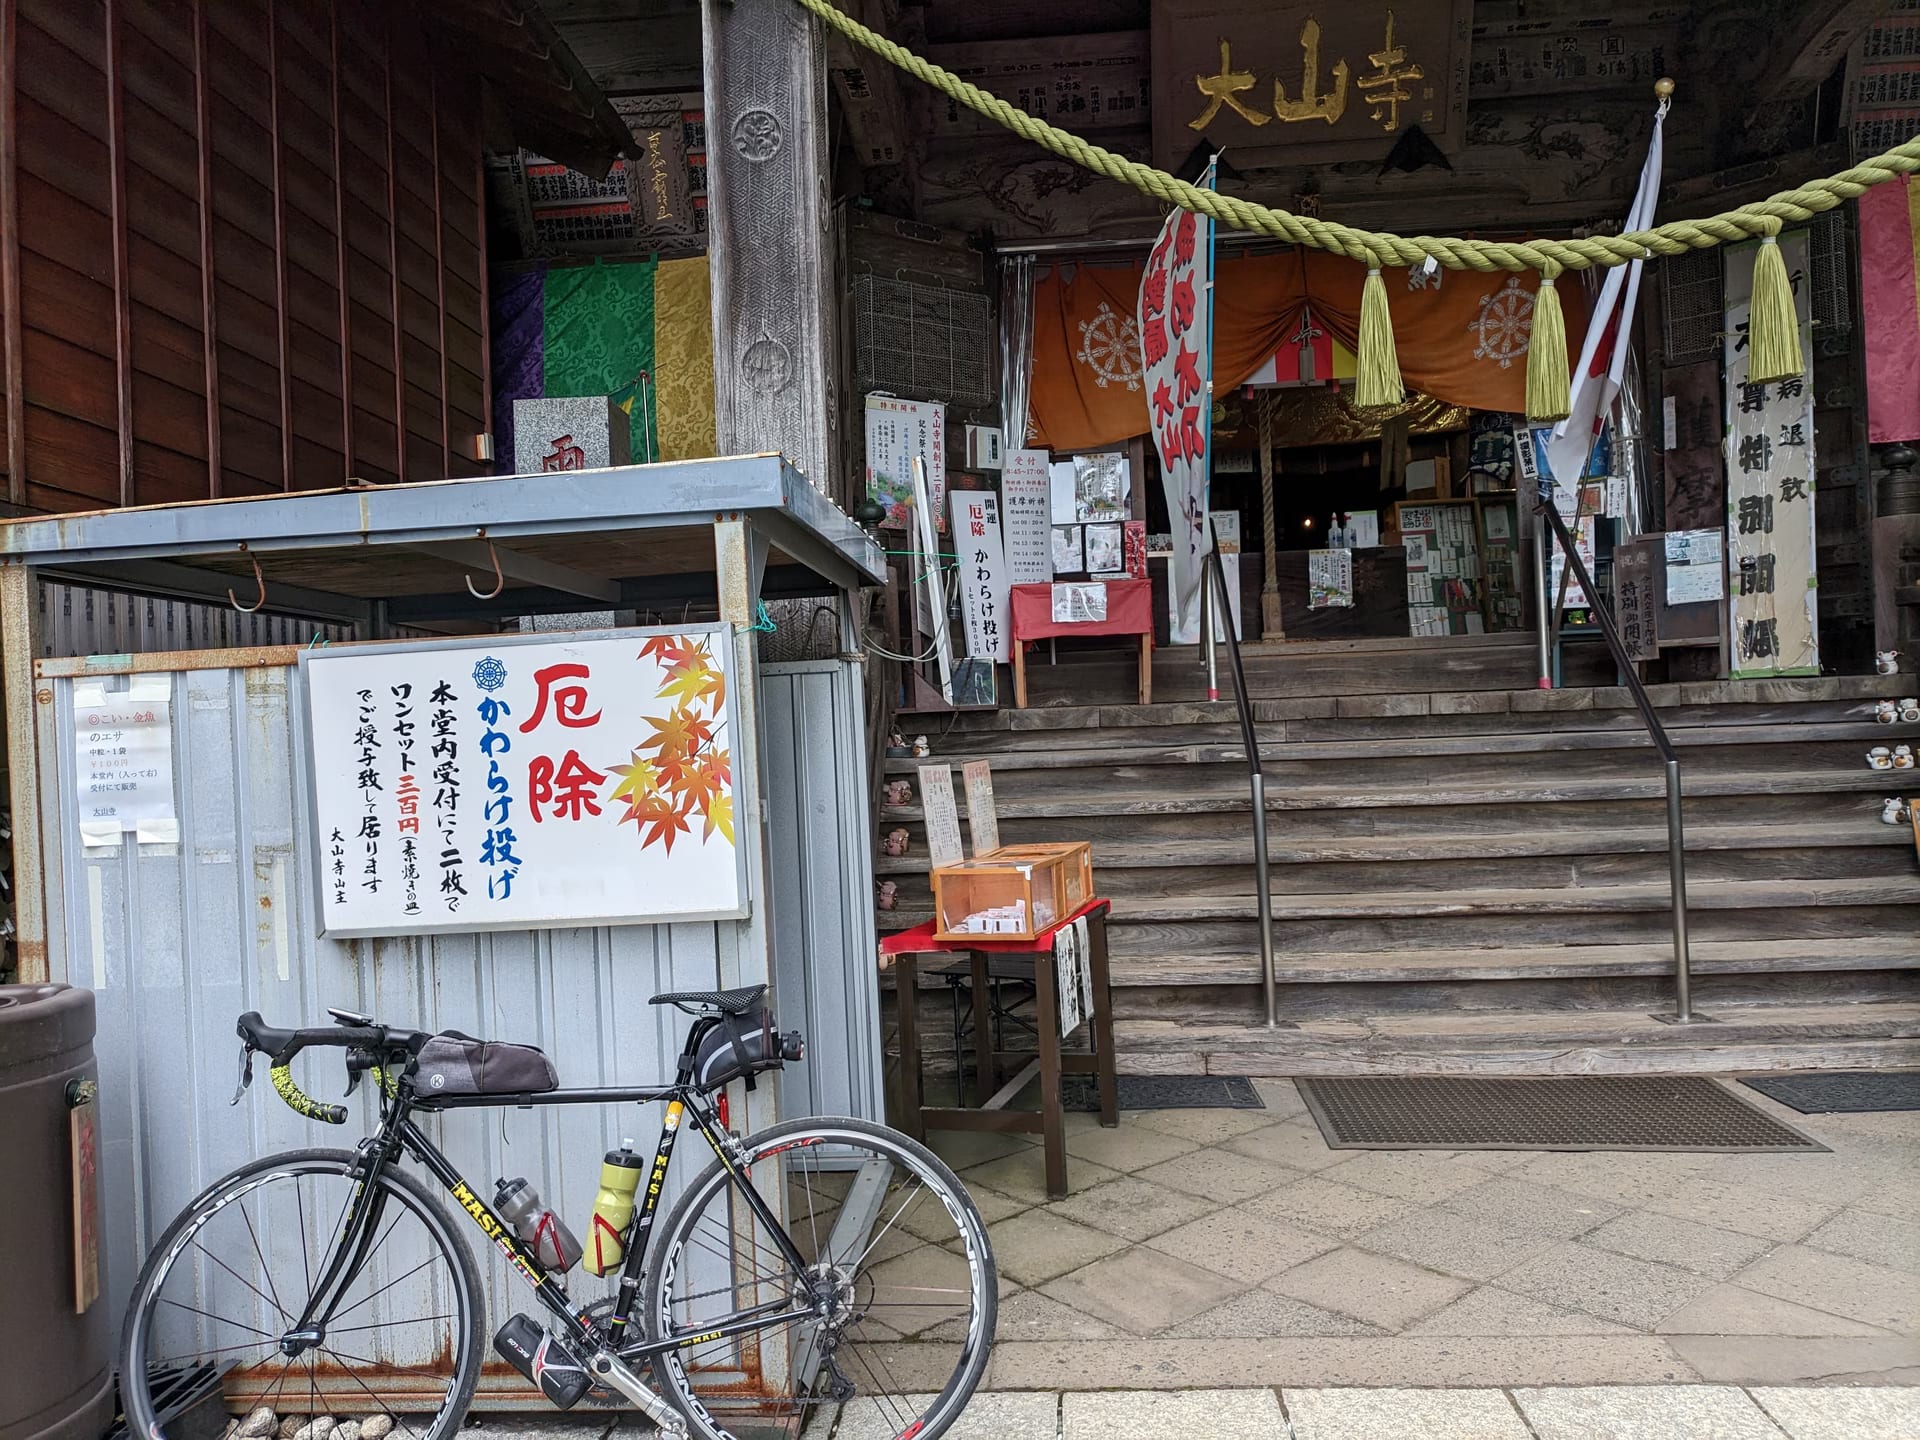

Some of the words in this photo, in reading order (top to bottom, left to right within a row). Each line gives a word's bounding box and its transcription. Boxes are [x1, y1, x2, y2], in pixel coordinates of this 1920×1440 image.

[1188, 9, 1424, 131] 大山寺
[1014, 456, 1037, 466] 受付
[968, 504, 985, 537] 厄除
[984, 499, 998, 524] 開運
[974, 548, 999, 654] かわらけ投げ
[90, 730, 124, 742] のエサ
[519, 663, 608, 823] 厄除
[90, 782, 137, 793] 受付にて販売
[93, 807, 117, 817] 大山寺
[353, 689, 384, 895] でご授与致して居ります
[428, 679, 468, 912] 本堂内受付にて二枚で
[477, 696, 523, 901] かわらけ投げ
[330, 826, 348, 905] 大山寺山主
[647, 1155, 668, 1209] MASI
[453, 1183, 503, 1239] MASI
[921, 1176, 980, 1335] ZONDA
[692, 1331, 723, 1345] MASI
